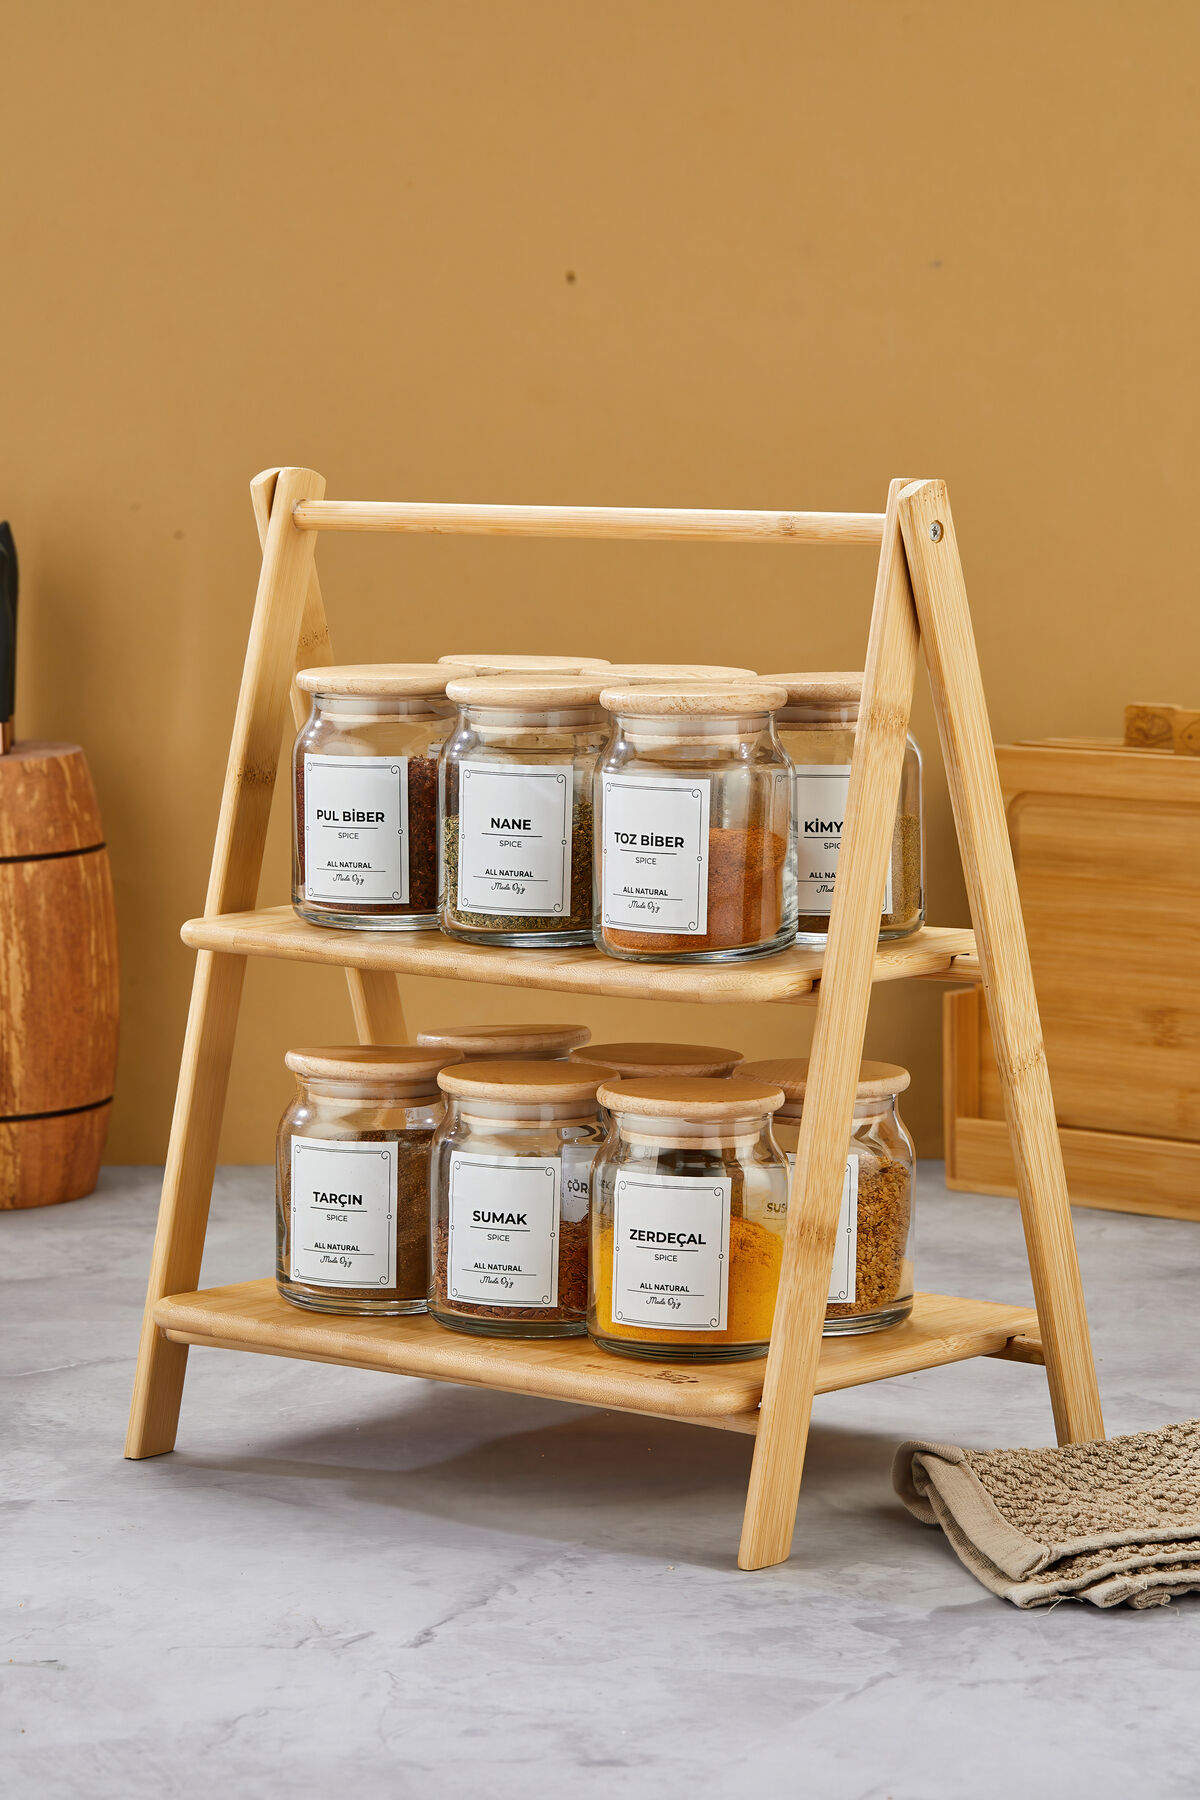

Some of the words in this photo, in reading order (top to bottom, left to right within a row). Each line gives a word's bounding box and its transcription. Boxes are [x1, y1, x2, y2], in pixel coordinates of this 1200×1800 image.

[316, 809, 340, 822] PUL
[342, 808, 385, 823] BİBER
[491, 817, 532, 831] NANE
[804, 818, 843, 833] KİMY
[338, 832, 359, 840] SPICE
[614, 831, 637, 845] TOZ
[640, 832, 685, 848] BİBER
[499, 840, 522, 848] SPICE
[339, 861, 372, 869] NATURAL
[635, 856, 657, 865] SPICE
[485, 868, 498, 876] ALL
[498, 869, 534, 878] NATURAL
[622, 886, 634, 894] ALL
[635, 887, 668, 896] NATURAL
[313, 1191, 363, 1207] TARÇIN
[766, 1202, 787, 1213] SUS
[326, 1214, 348, 1222] SPICE
[472, 1210, 528, 1225] SUMAK
[487, 1233, 510, 1242] SPICE
[629, 1228, 707, 1248] ZERDEÇAL
[314, 1242, 326, 1250] ALL
[327, 1243, 360, 1252] NATURAL
[654, 1253, 678, 1262] SPICE
[473, 1262, 486, 1270] ALL
[487, 1263, 522, 1272] NATURAL
[639, 1282, 652, 1290] ALL
[654, 1283, 690, 1292] NATURAL
